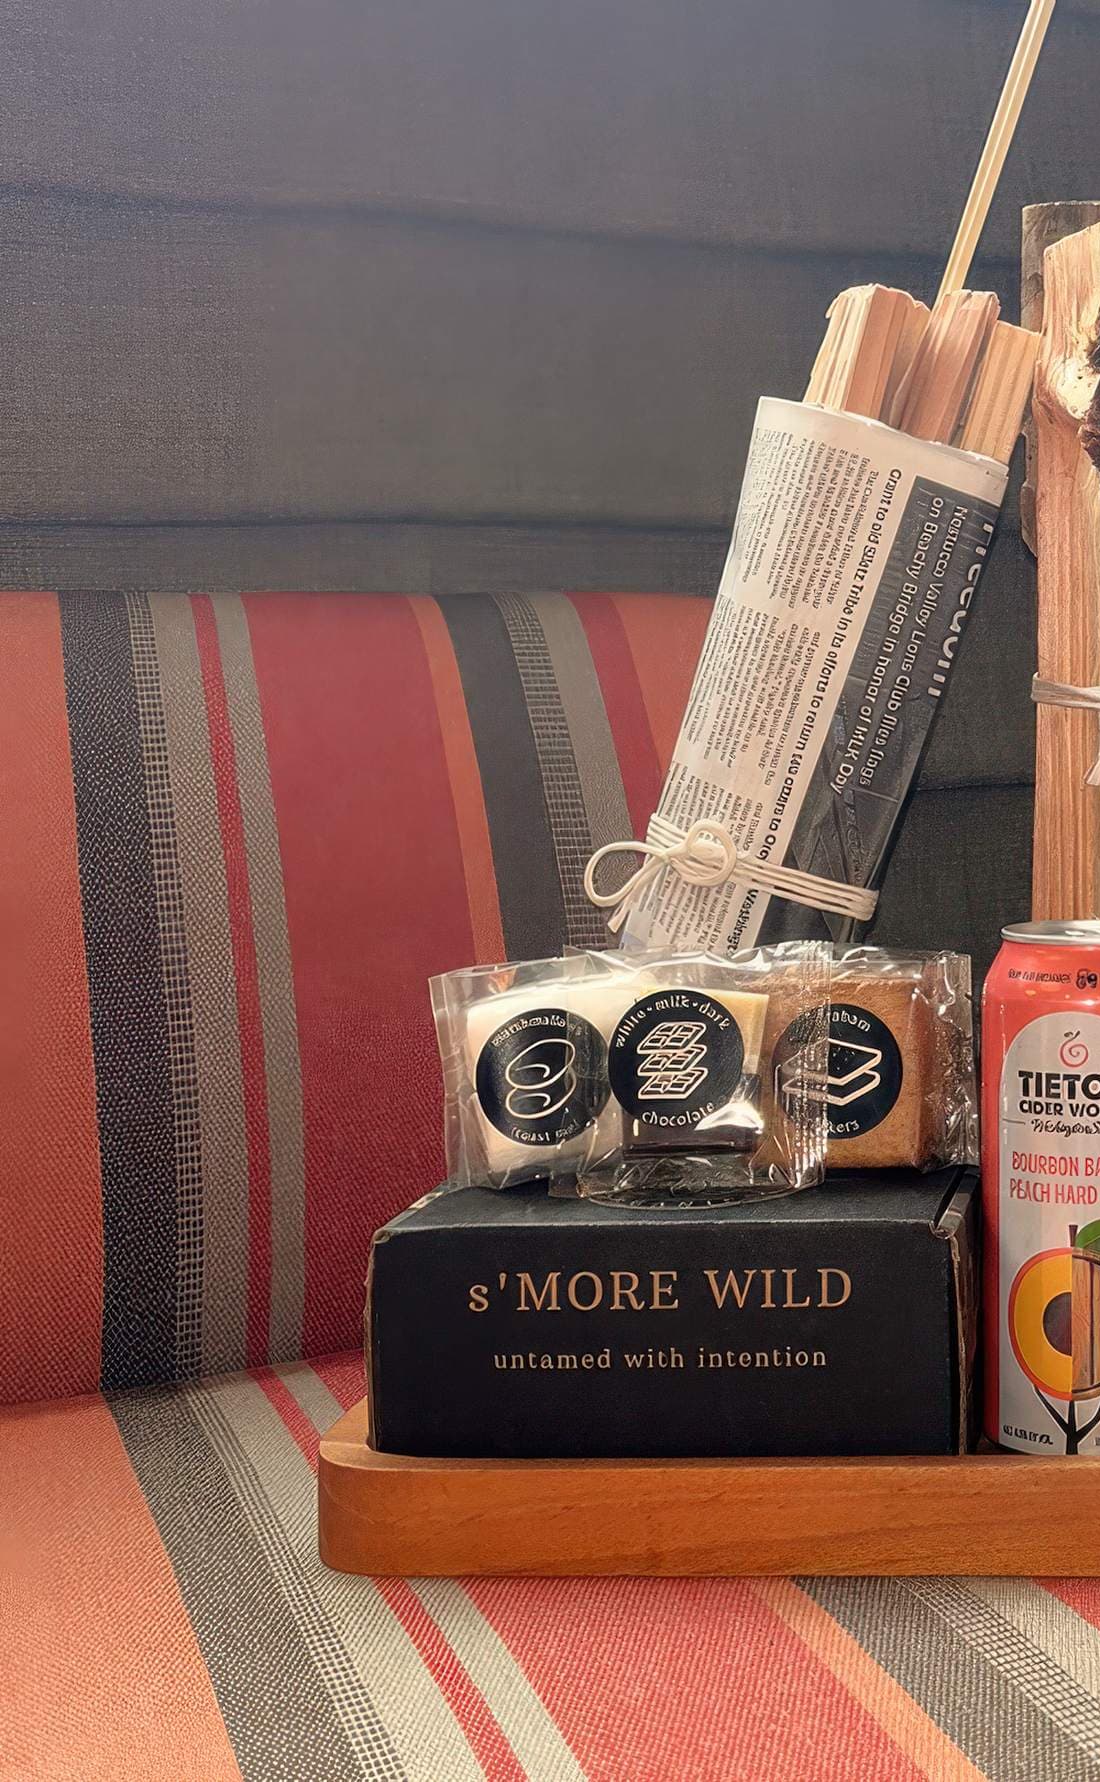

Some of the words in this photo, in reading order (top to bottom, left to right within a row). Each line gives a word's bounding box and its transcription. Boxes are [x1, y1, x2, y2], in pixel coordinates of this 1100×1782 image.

[879, 467, 902, 506] Grant
[874, 506, 889, 522] to
[928, 496, 944, 517] on
[903, 519, 938, 580] Beachy
[841, 582, 863, 616] Tribe
[885, 580, 917, 635] Bridge
[913, 579, 943, 628] Valley
[836, 617, 851, 632] in
[882, 637, 898, 653] in
[900, 629, 925, 673] Lions
[815, 650, 839, 694] efforts
[864, 655, 892, 704] honor
[809, 694, 824, 709] to
[886, 673, 911, 712] Club
[858, 705, 874, 722] of
[843, 724, 867, 761] MLK
[827, 760, 854, 795] Day
[856, 747, 884, 788] flags
[767, 817, 780, 832] to
[641, 1102, 716, 1127] chocolate
[1019, 1101, 1063, 1117] CIDER
[1012, 1151, 1079, 1177] BOURBON
[1009, 1179, 1049, 1203] PEACH
[1055, 1183, 1098, 1205] HARD
[468, 1271, 679, 1312] s'MORE
[704, 1267, 853, 1310] WILD
[494, 1348, 611, 1370] untamed
[625, 1347, 684, 1369] with
[698, 1347, 827, 1368] intention
